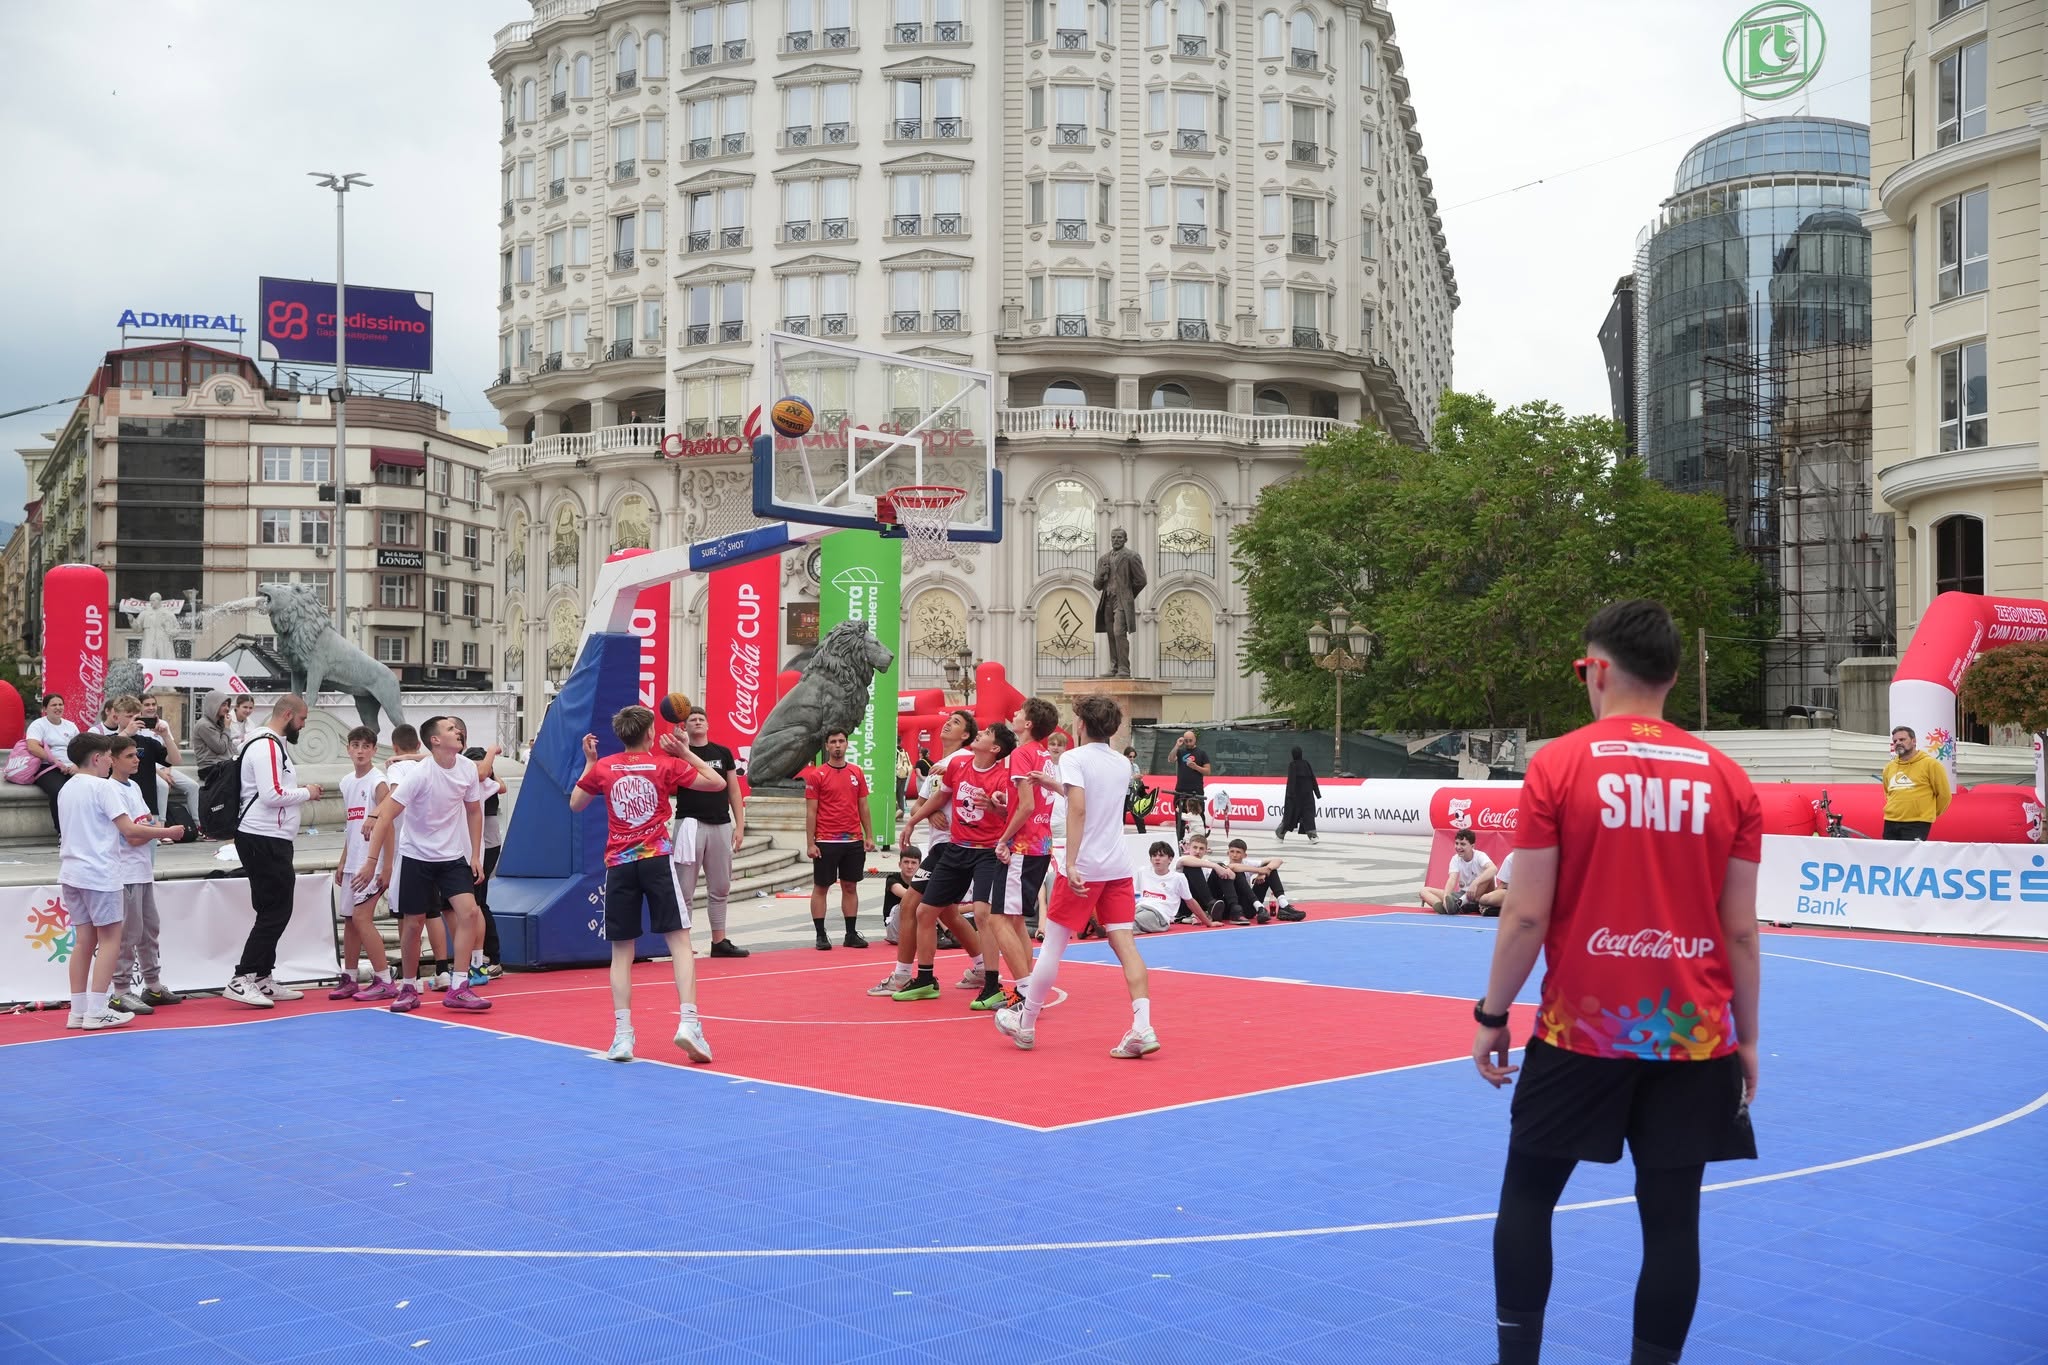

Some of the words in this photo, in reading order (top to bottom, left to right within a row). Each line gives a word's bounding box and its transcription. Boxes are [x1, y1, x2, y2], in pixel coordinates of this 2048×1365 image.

[117, 309, 247, 333] ADMIRAL
[661, 432, 743, 459] Casino
[380, 556, 422, 567] LONDON
[701, 546, 718, 558] SURE
[727, 540, 745, 551] SHOT
[737, 583, 761, 639] CUP
[84, 604, 103, 651] CUP
[1325, 807, 1354, 819] ИГРИ
[1357, 808, 1371, 819] ЗА
[1374, 808, 1420, 823] МЛАДИ
[1597, 773, 1712, 835] STAFF
[1799, 861, 2012, 902] SPARKASSE
[1797, 895, 1848, 916] Bank
[1587, 926, 1673, 959] Coca-Cola
